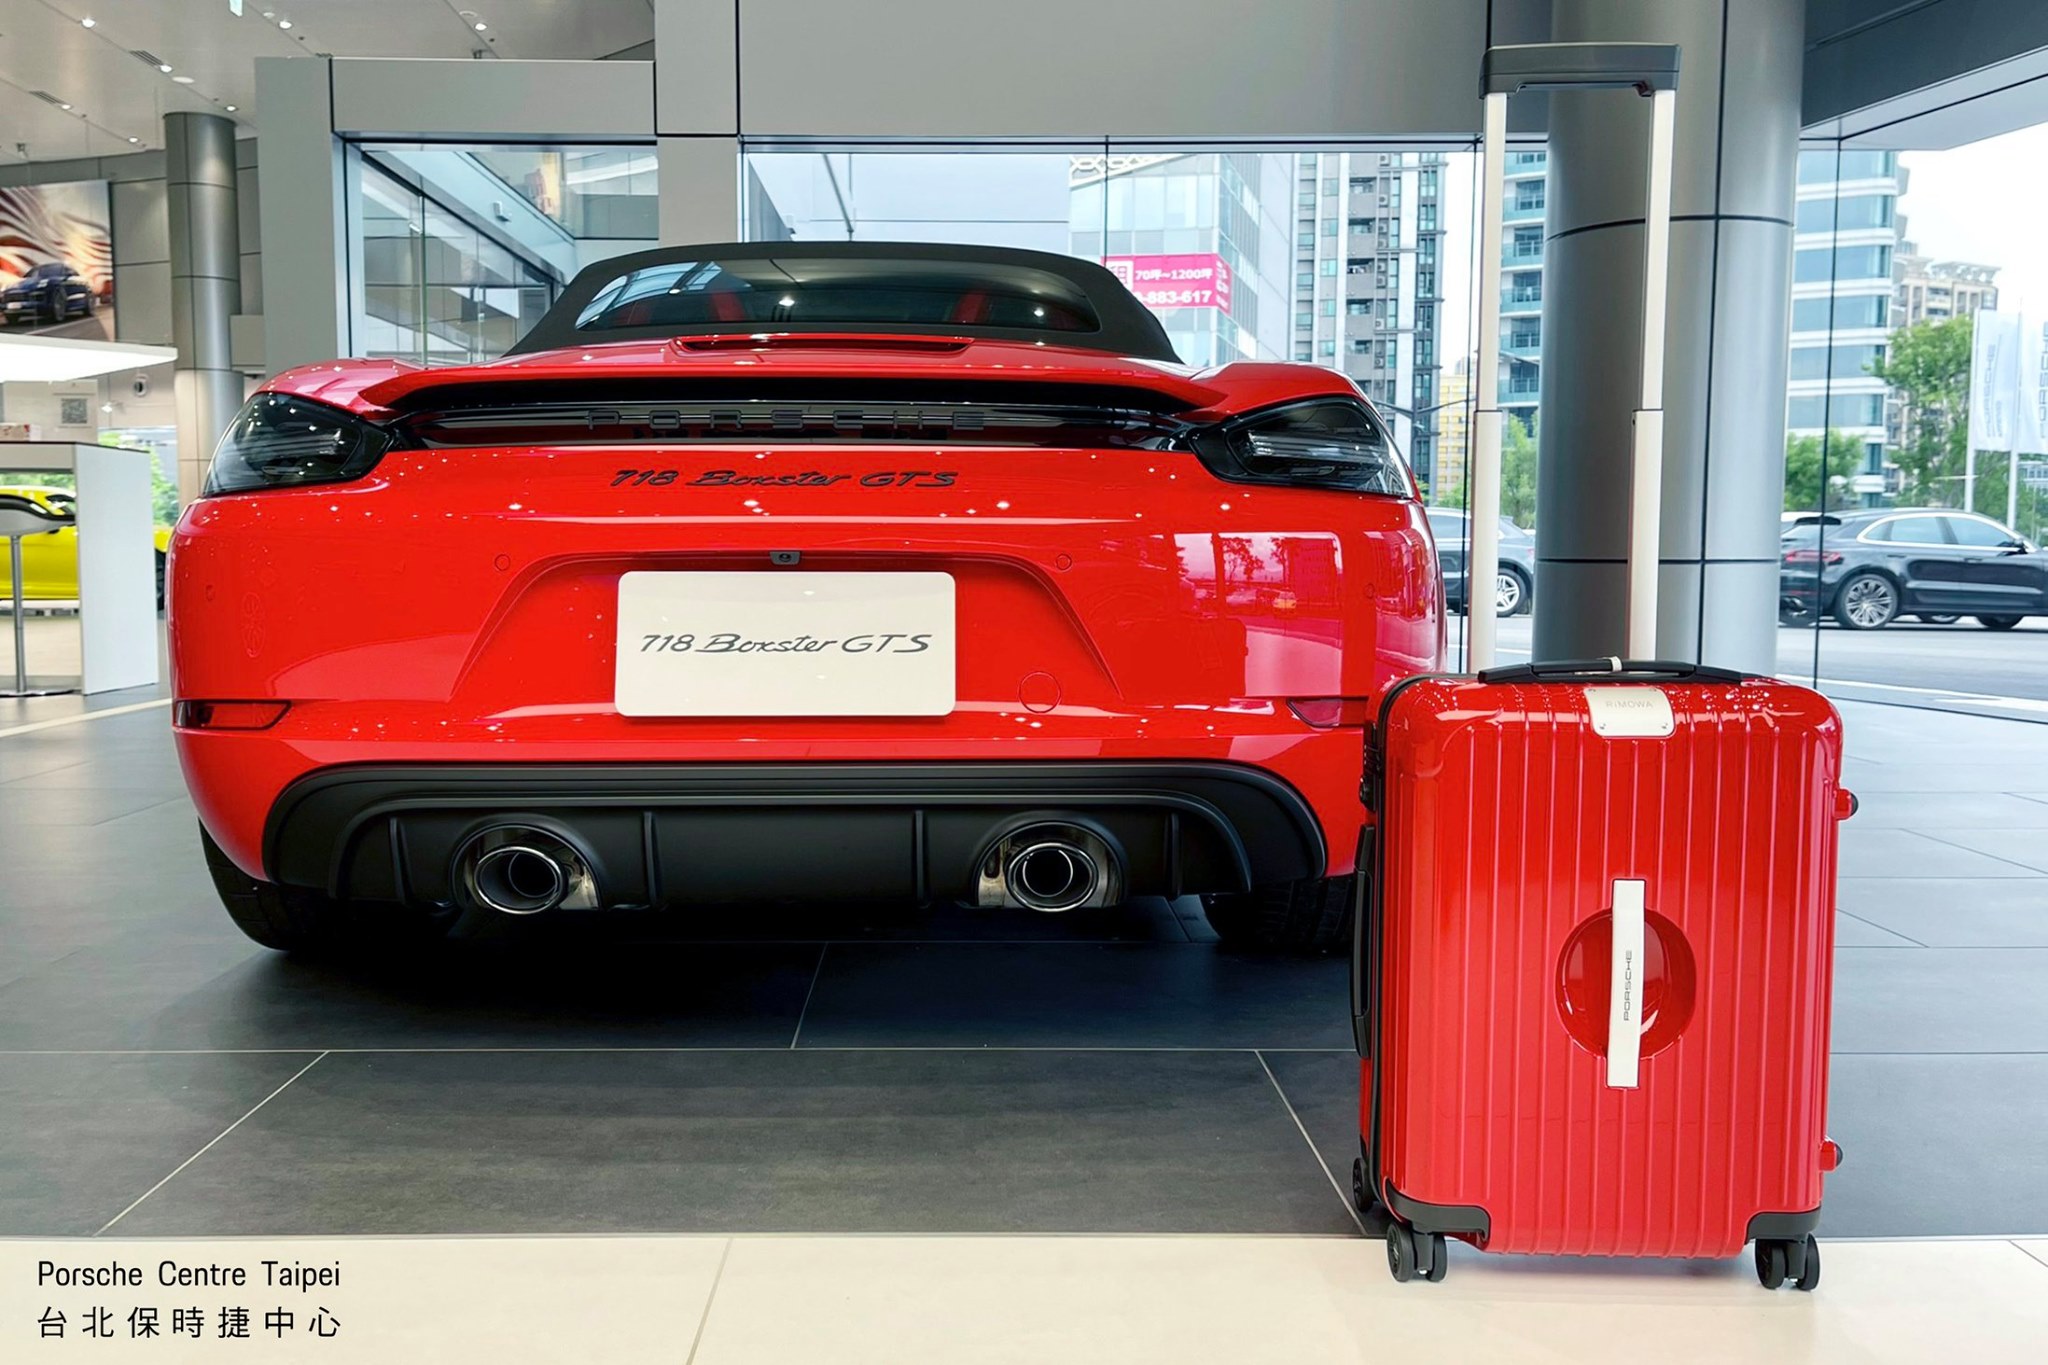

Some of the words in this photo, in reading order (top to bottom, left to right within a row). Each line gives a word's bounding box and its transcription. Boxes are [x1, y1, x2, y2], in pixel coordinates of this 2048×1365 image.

[587, 409, 985, 430] PORSCHE
[610, 469, 680, 487] 718
[687, 469, 856, 487] Boxster
[859, 471, 959, 487] GTS
[641, 634, 695, 652] 718
[695, 633, 838, 652] Boxster
[841, 634, 933, 653] GTS
[1605, 700, 1654, 709] RIMOWA
[1623, 950, 1632, 1021] PORSCHE
